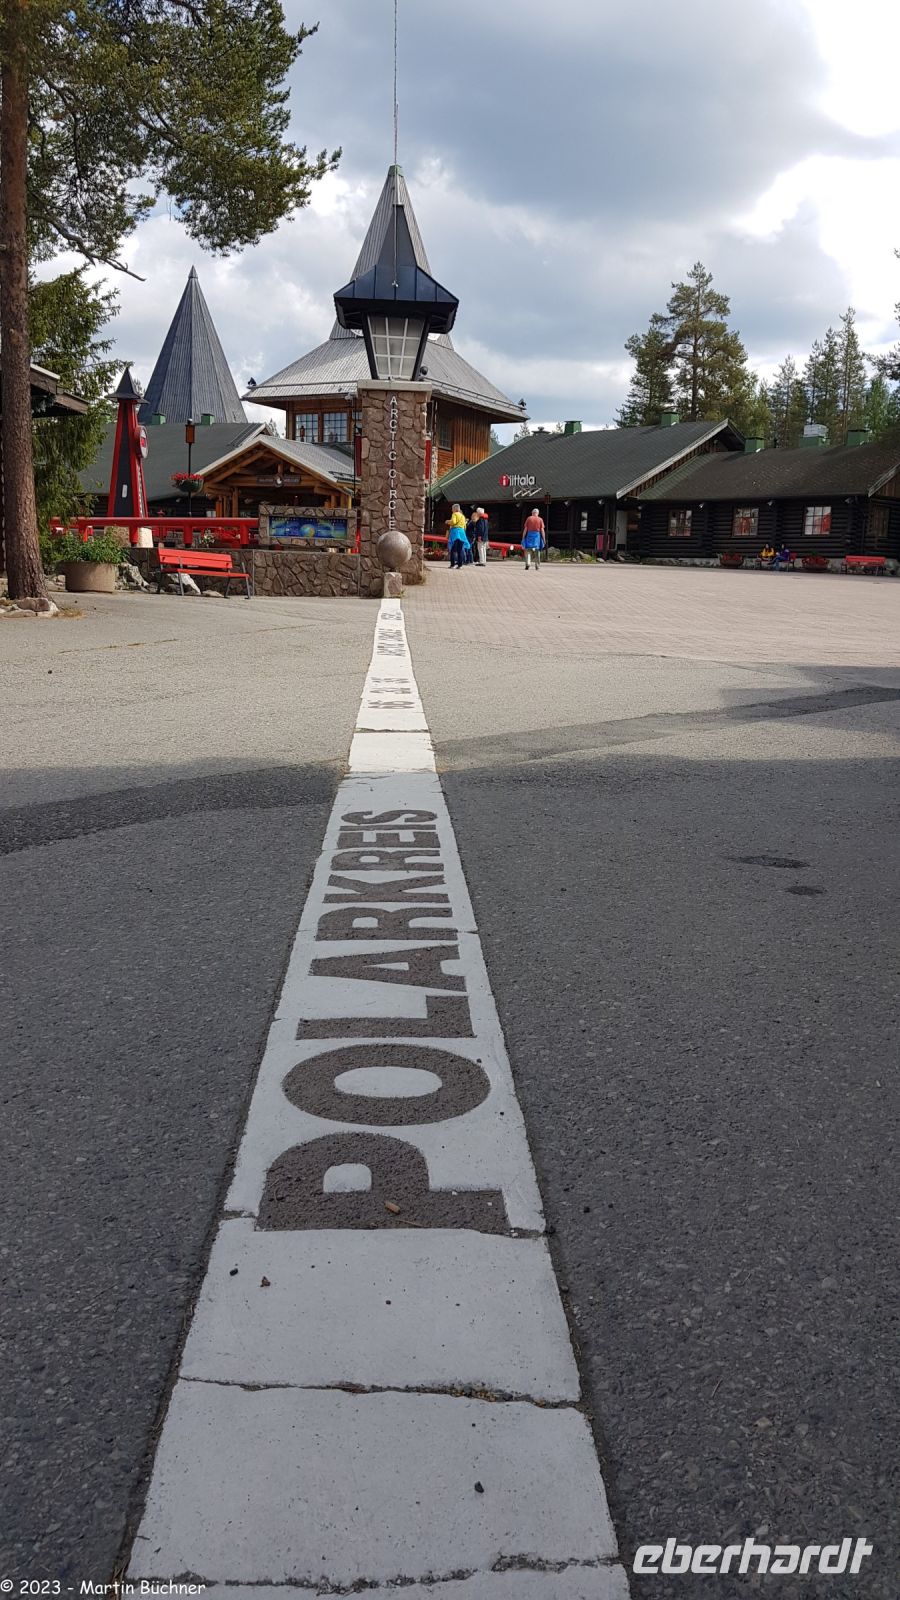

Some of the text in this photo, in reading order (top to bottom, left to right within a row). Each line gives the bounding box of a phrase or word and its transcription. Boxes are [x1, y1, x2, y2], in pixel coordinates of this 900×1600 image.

[388, 396, 399, 530] ARCTIC CIRCLE
[509, 473, 536, 486] iittala
[255, 809, 509, 1231] POLARKREIS
